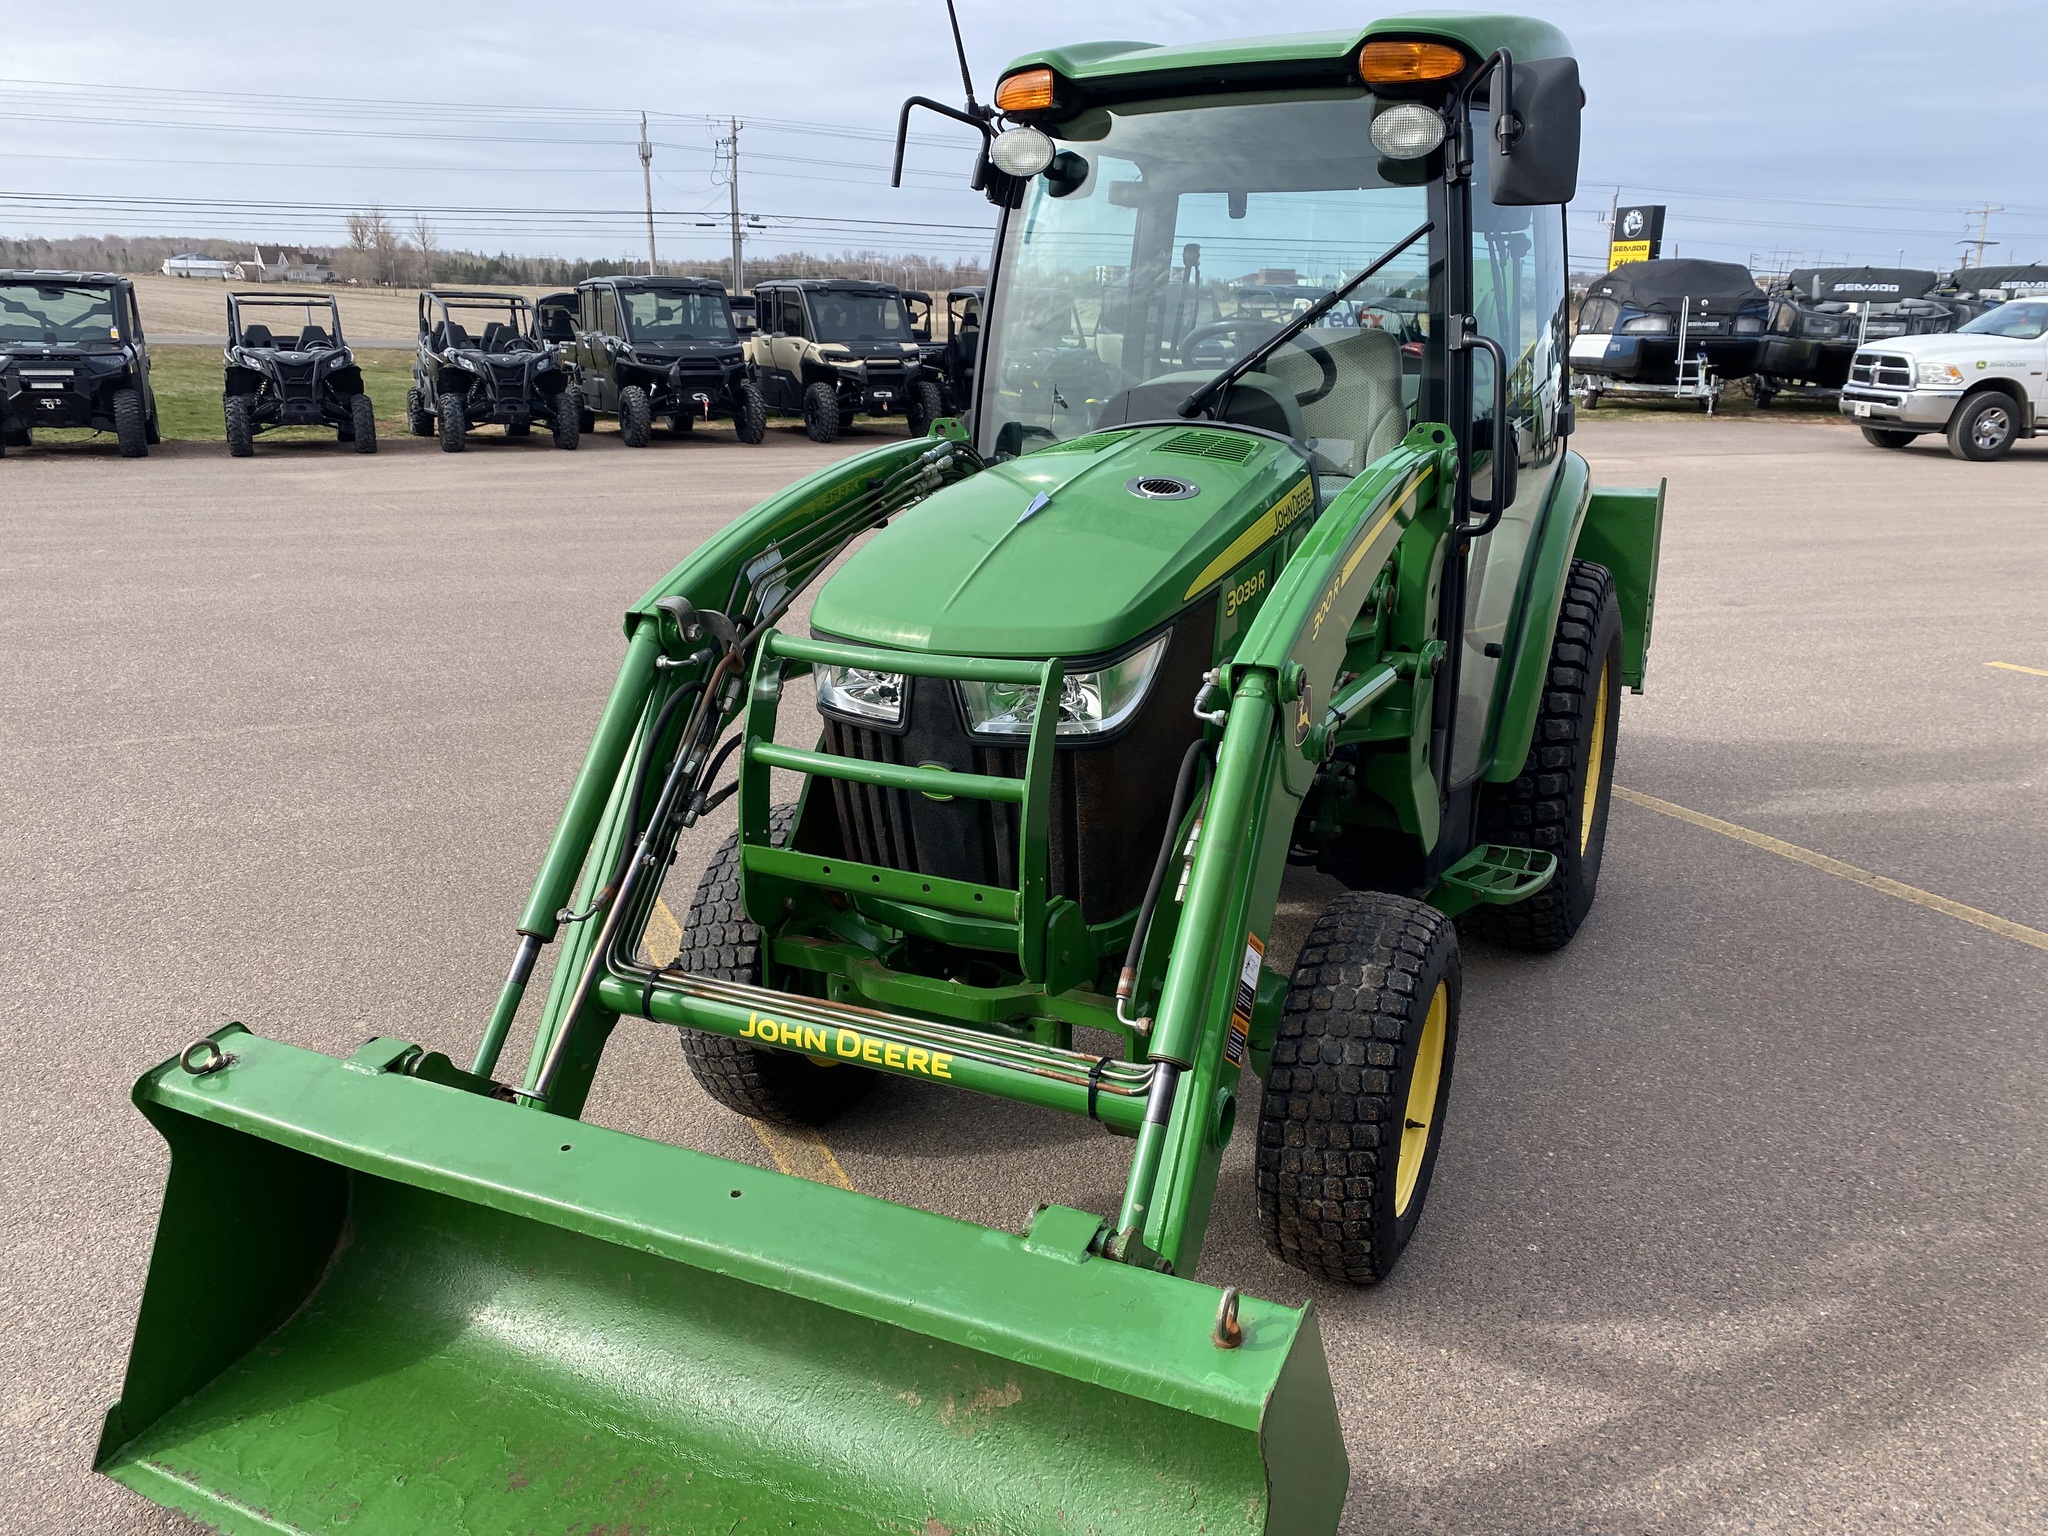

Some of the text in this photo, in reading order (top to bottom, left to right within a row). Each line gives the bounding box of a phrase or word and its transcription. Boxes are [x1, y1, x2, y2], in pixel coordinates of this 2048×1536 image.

[1273, 486, 1312, 536] JOHN DEERE
[739, 1011, 954, 1079] JOHN DEERE
